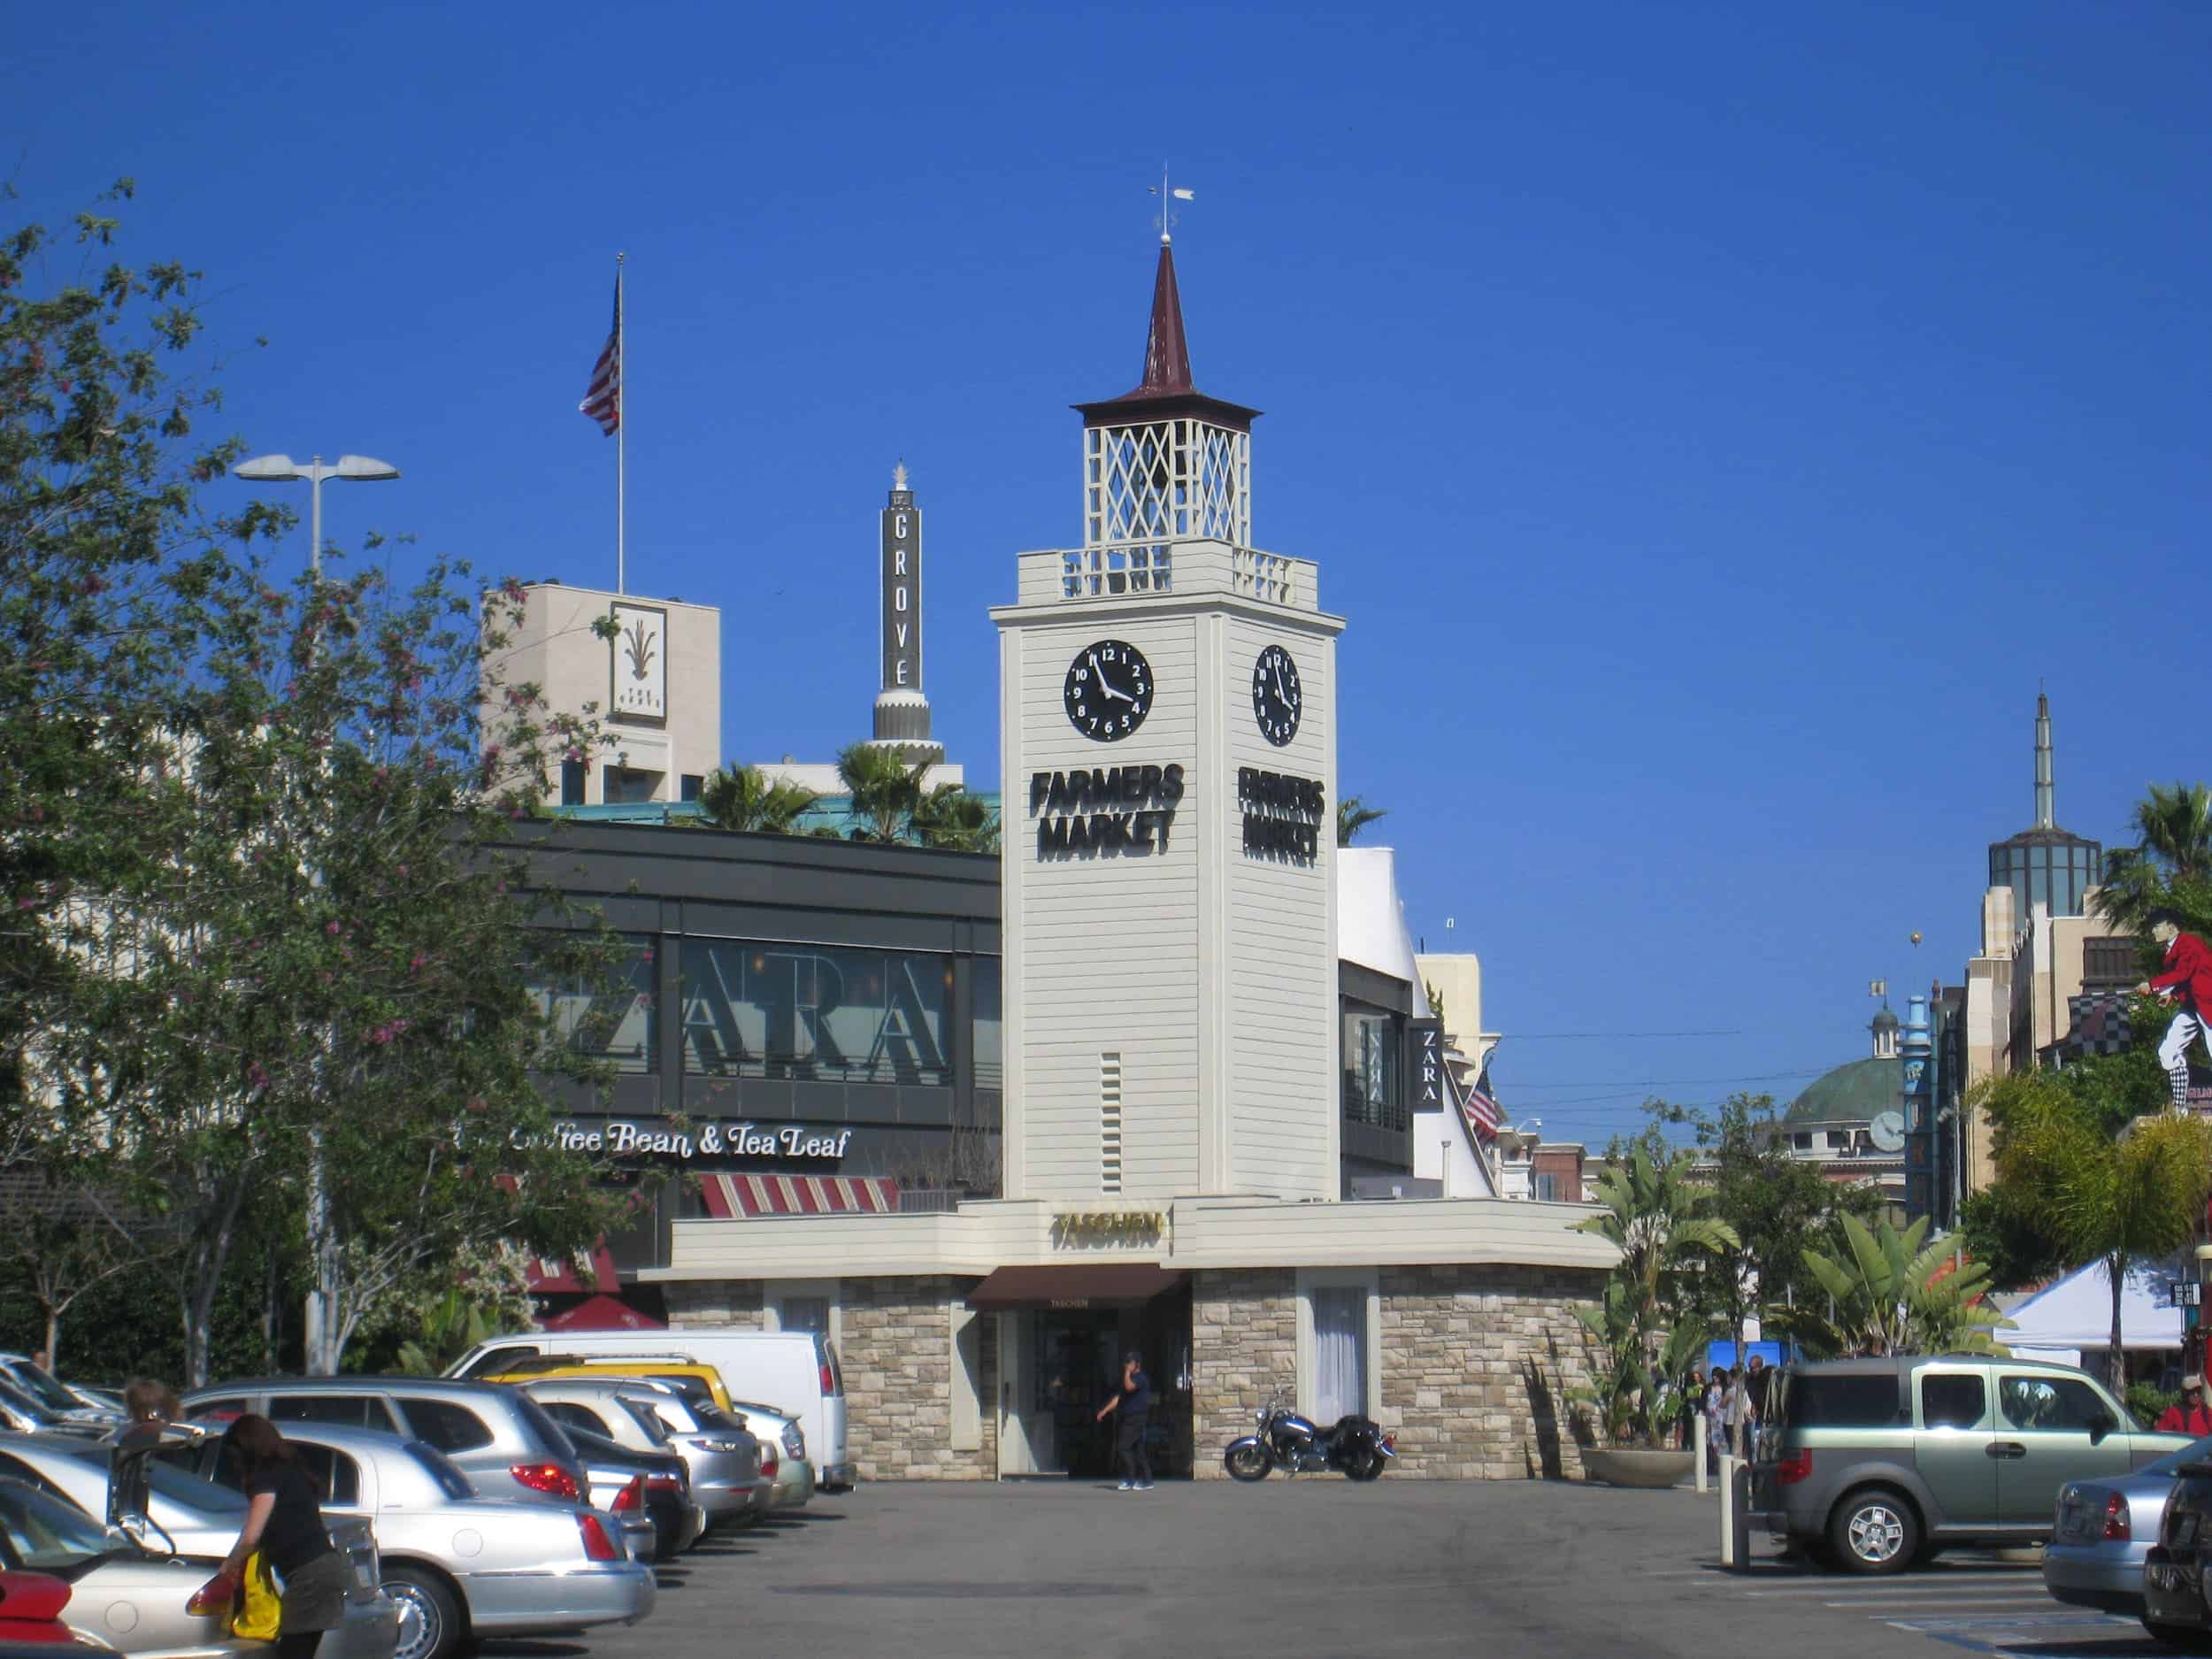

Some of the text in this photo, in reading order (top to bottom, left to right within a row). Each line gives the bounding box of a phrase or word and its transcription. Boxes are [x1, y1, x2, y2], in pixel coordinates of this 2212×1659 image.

[895, 515, 907, 686] GROVE
[1102, 649, 1115, 661] 12
[1122, 652, 1126, 664] 1
[1266, 657, 1271, 669] 11
[1285, 660, 1288, 672] 1
[1075, 669, 1087, 681] 10
[1133, 664, 1141, 677] 2
[1259, 668, 1267, 680] 10
[1290, 675, 1295, 687] 2
[1073, 687, 1082, 699] 9
[1136, 682, 1144, 695] 3
[1258, 686, 1263, 698] 9
[1293, 693, 1297, 705] 3
[1078, 705, 1086, 717] 8
[1132, 702, 1141, 714] 4
[1260, 705, 1265, 718] 8
[1090, 718, 1097, 729] 7
[1121, 715, 1129, 727] 5
[1290, 711, 1295, 724] 4
[1104, 721, 1113, 733] 6
[1267, 719, 1272, 732] 7
[1284, 723, 1289, 734] 5
[1275, 726, 1280, 738] 6
[1031, 764, 1184, 813] FARMERS
[1038, 810, 1175, 858] MARKET
[1423, 1032, 1437, 1100] ZARA
[606, 1123, 692, 1158] Bean
[700, 1125, 723, 1154] &
[727, 1125, 776, 1155] Tea
[780, 1128, 851, 1157] Leaf
[1051, 1212, 1163, 1239] TASCHEN
